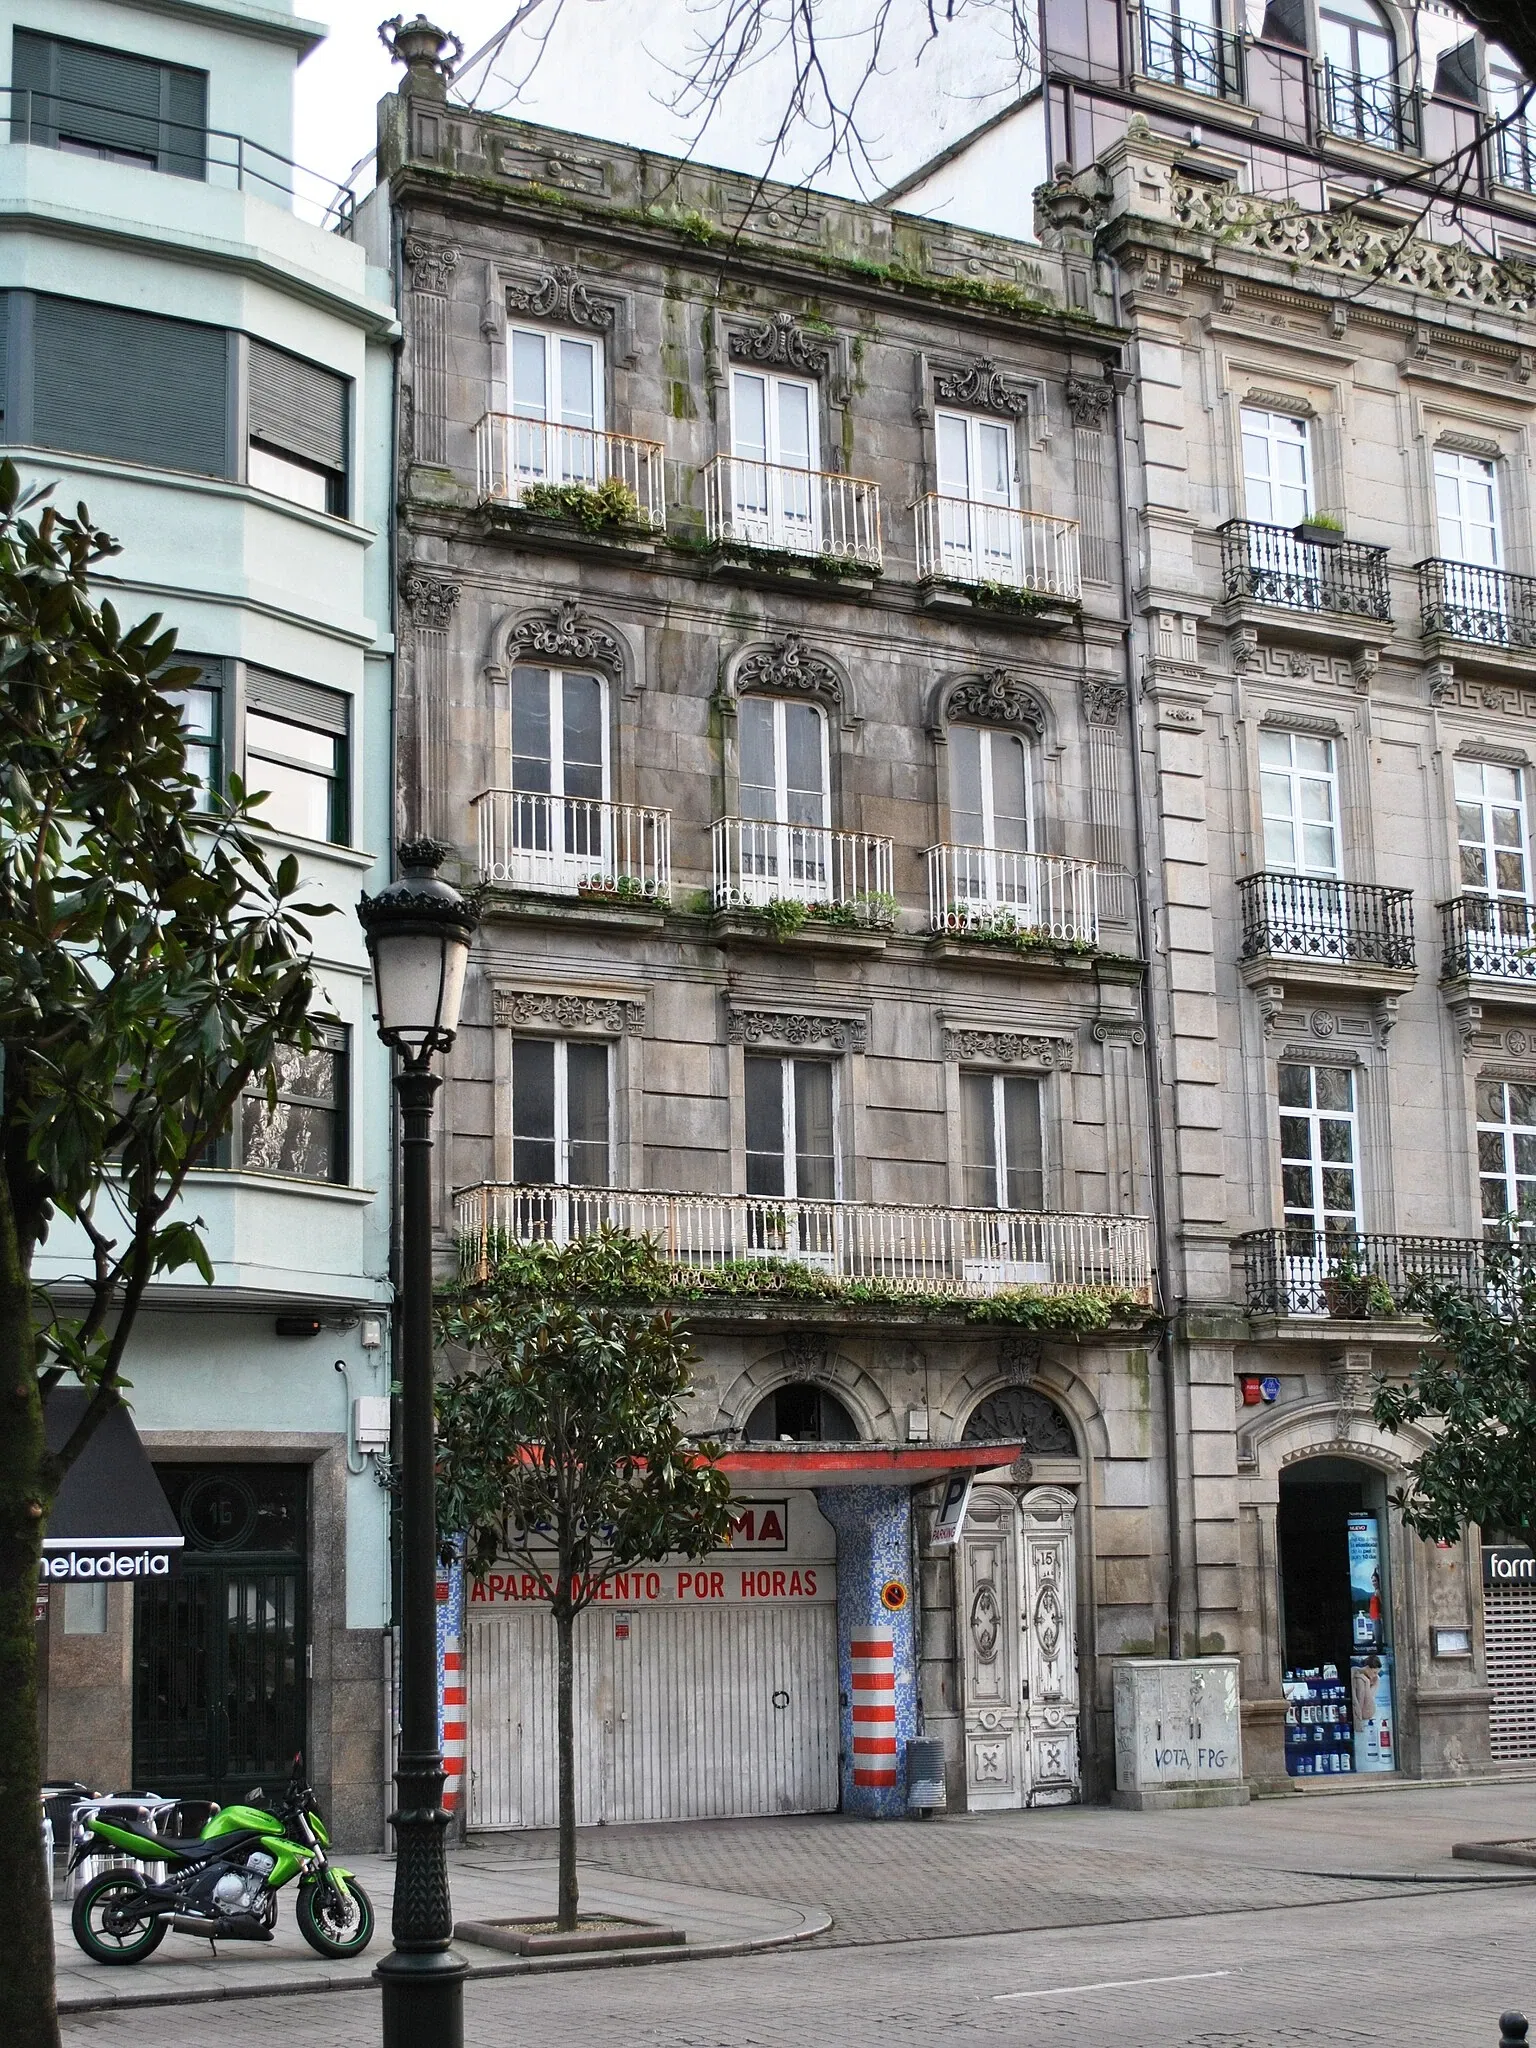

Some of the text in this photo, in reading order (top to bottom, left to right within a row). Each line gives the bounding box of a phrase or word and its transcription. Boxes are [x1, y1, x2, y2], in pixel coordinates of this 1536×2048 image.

[940, 1477, 966, 1523] P
[932, 1526, 956, 1541] PARKING
[1041, 1552, 1053, 1565] 15
[471, 1572, 661, 1602] APARCMIENTO
[678, 1571, 725, 1599] POR
[741, 1569, 817, 1598] HORAS
[1198, 1748, 1228, 1768] FPG
